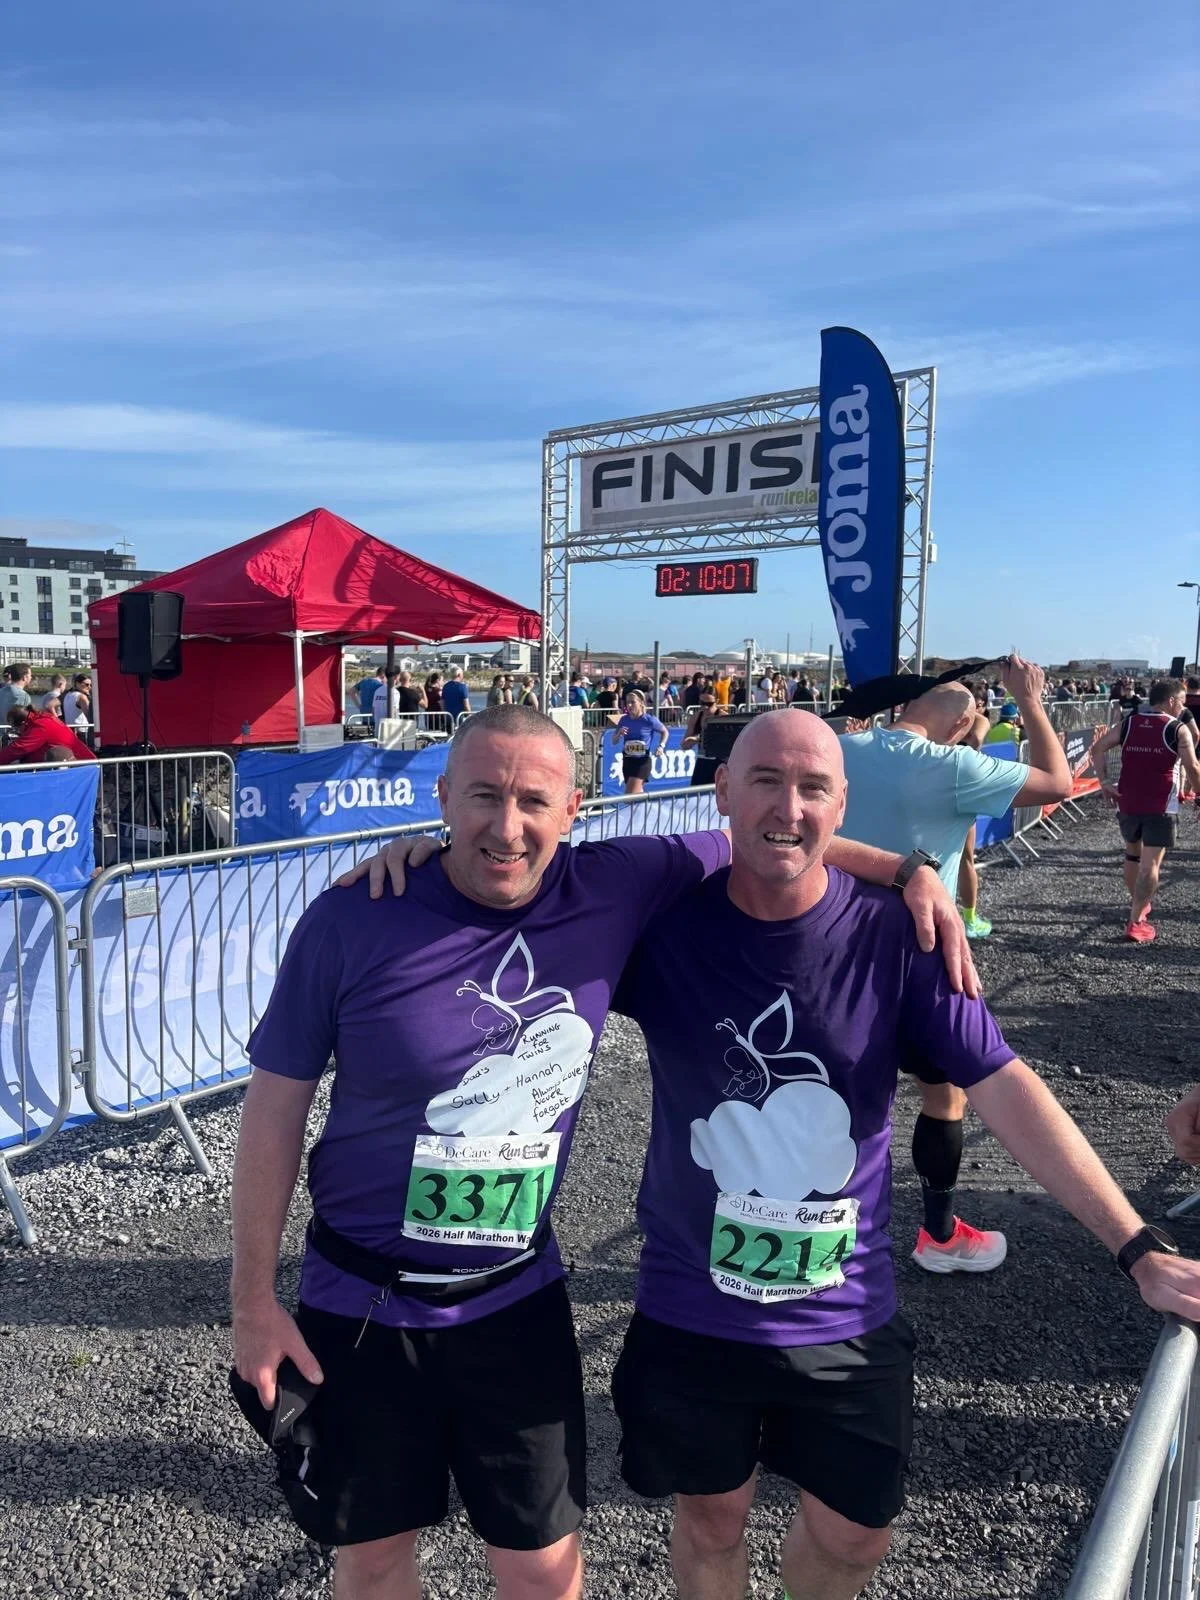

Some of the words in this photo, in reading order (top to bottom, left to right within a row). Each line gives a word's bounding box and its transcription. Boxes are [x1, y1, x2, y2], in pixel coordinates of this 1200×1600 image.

[659, 563, 750, 593] 02:10:07
[516, 1062, 562, 1088] Hannah
[445, 1145, 491, 1159] DeCare
[499, 1143, 521, 1161] Run
[411, 1170, 545, 1225] 3371
[742, 1200, 788, 1220] DeCare
[795, 1207, 820, 1224] Run
[416, 1226, 440, 1239] 2026
[443, 1229, 464, 1240] Half
[467, 1230, 513, 1244] Marathon
[715, 1223, 847, 1281] 2214
[719, 1274, 741, 1290] 2026
[743, 1284, 764, 1297] Half
[766, 1287, 807, 1297] Marathon
